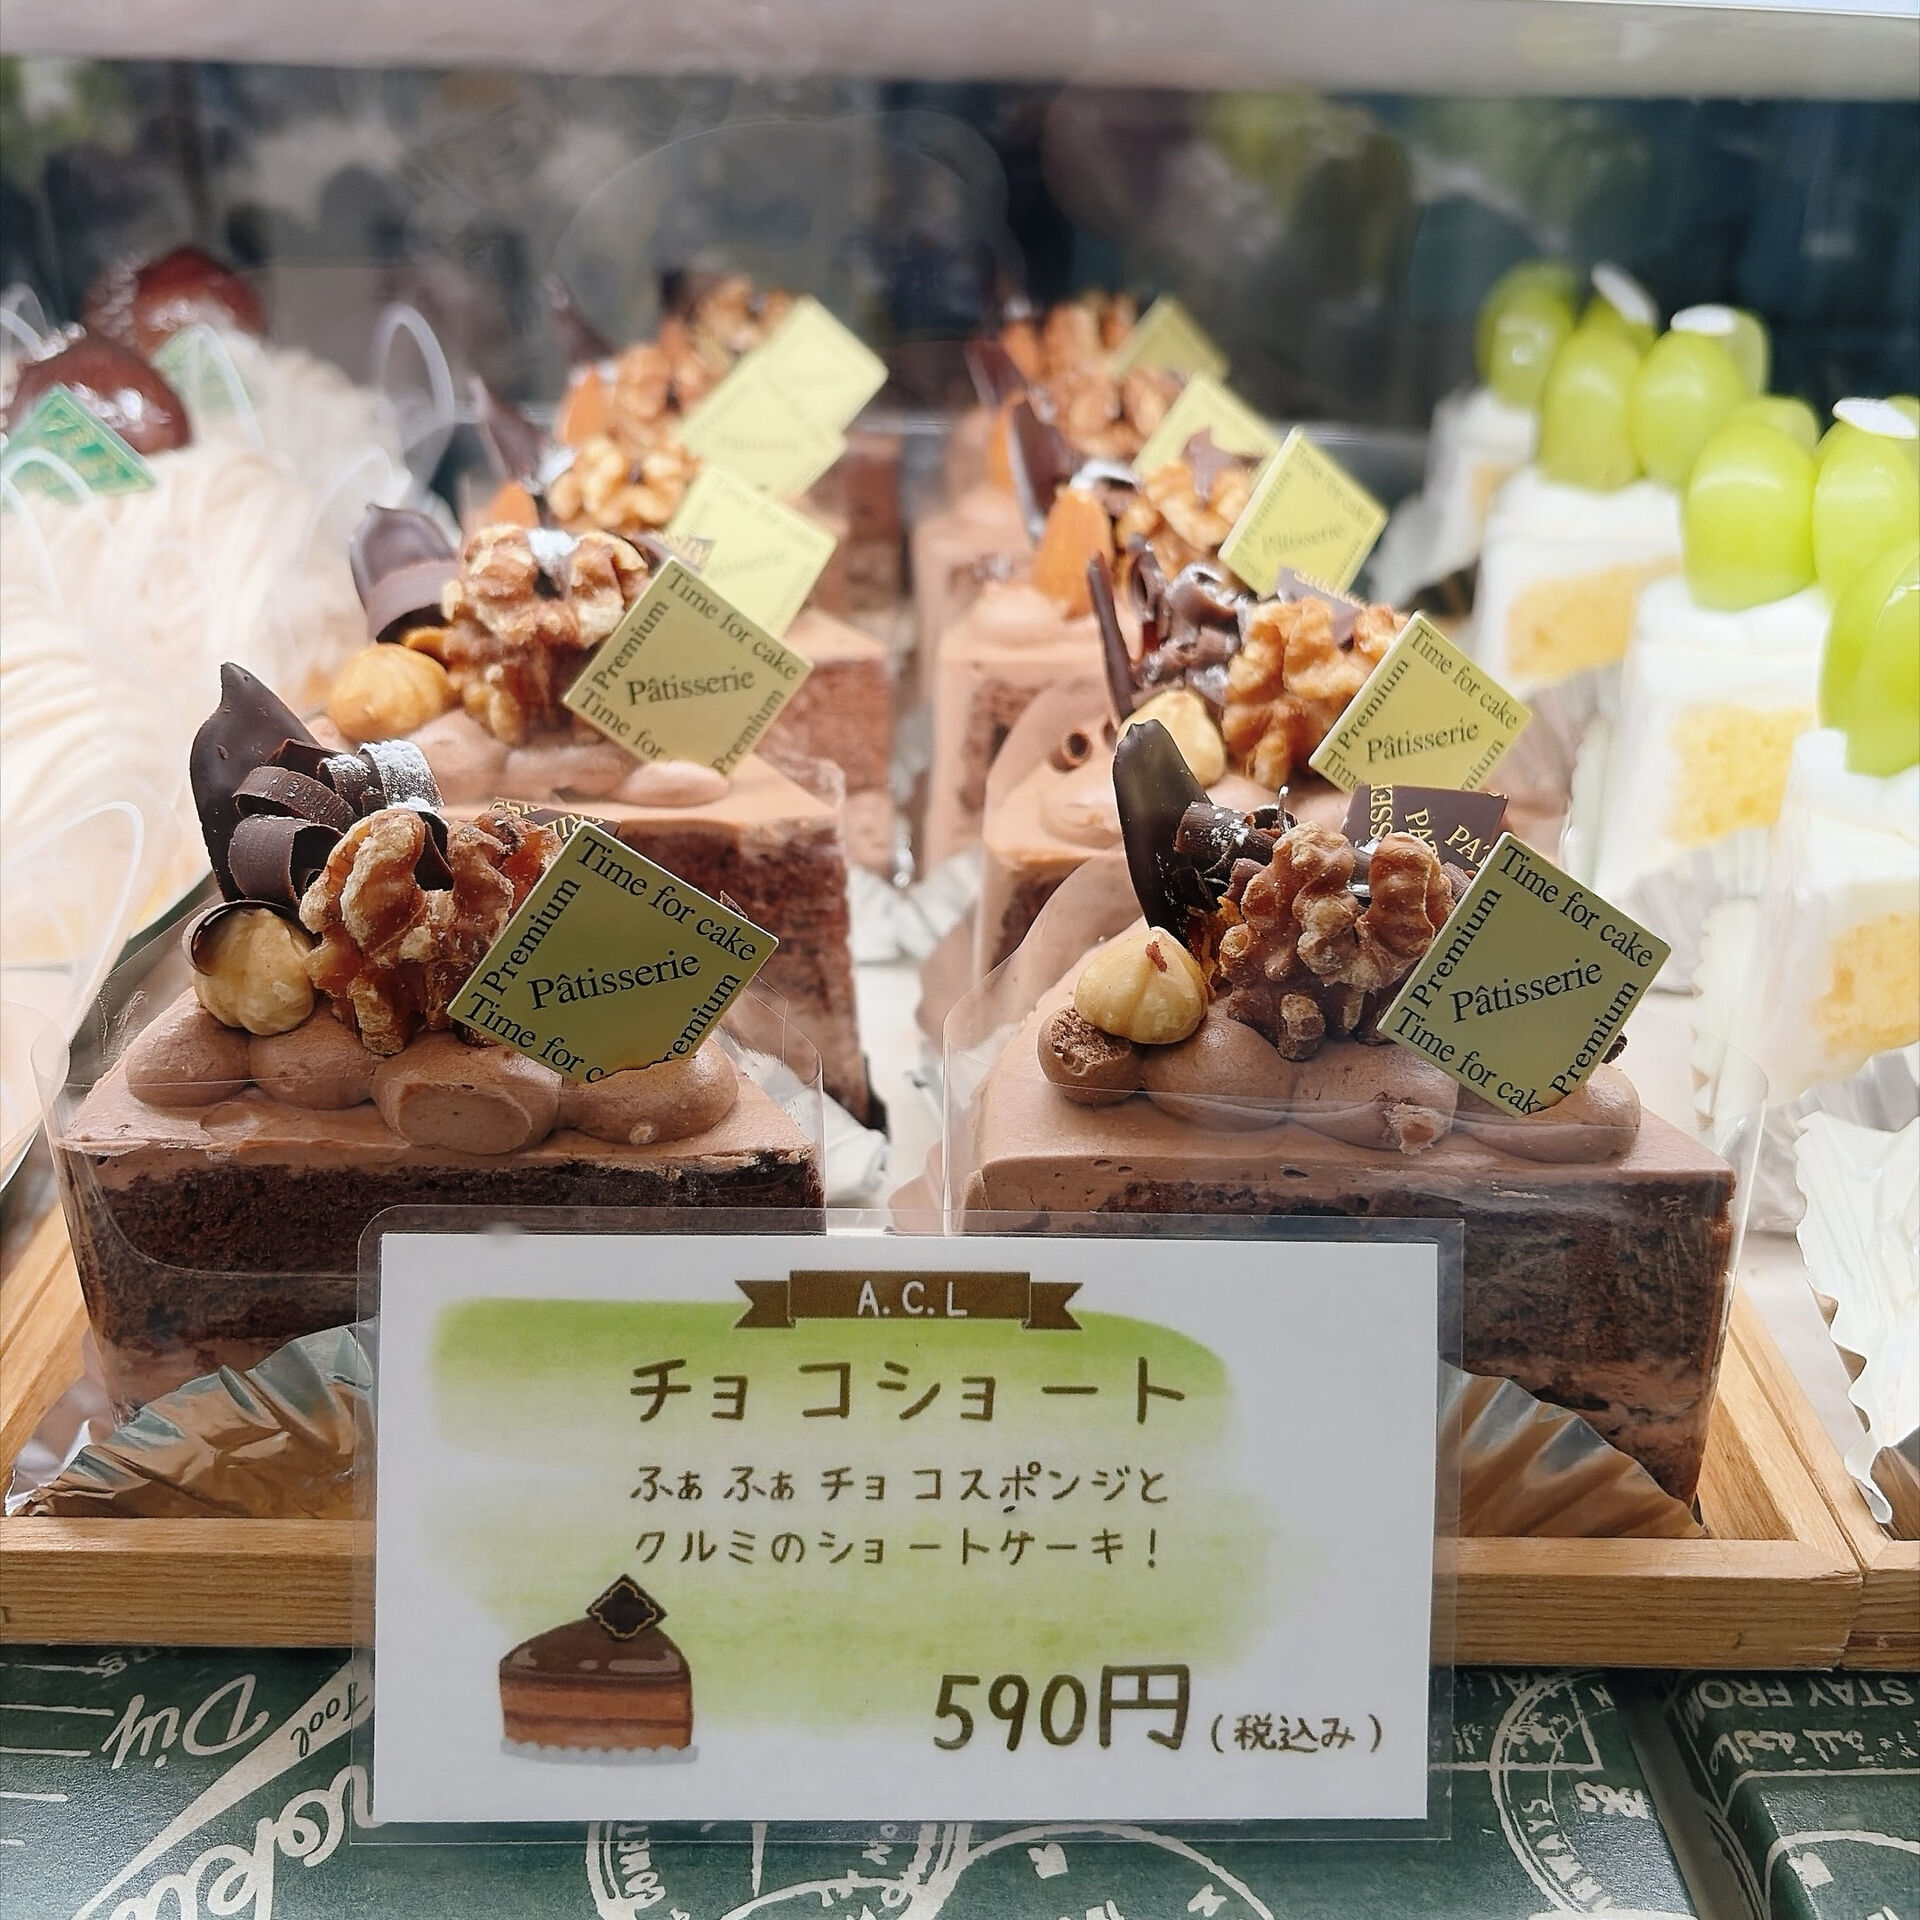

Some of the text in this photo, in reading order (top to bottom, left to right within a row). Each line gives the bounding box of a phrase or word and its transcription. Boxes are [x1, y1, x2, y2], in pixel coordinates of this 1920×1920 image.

[592, 599, 670, 690] Premium
[665, 566, 798, 681] Time for cake
[626, 665, 754, 706] Pâtisserie
[1337, 659, 1409, 750] Premium
[1409, 626, 1517, 731] Time for cake
[579, 687, 665, 758] Time for
[710, 688, 785, 777] Premium
[1366, 717, 1480, 764] Pâtisserie
[481, 878, 582, 996] Premium
[576, 836, 757, 961] Time for cake
[1499, 845, 1653, 968] Time for cake
[527, 950, 701, 1010] Pâtisserie
[1410, 888, 1502, 1008] Premium
[1450, 958, 1603, 1022] Pâtisserie
[465, 992, 536, 1049] Time
[538, 1036, 585, 1075] for
[651, 973, 742, 1064] remium
[1394, 1006, 1453, 1063] Time
[1456, 1051, 1498, 1088] for
[1549, 980, 1639, 1096] Premium
[858, 1280, 968, 1316] A.C.L
[630, 1357, 1186, 1425] チョコショート
[290, 1682, 369, 1757] Tool
[933, 1664, 1190, 1751] 590円
[1808, 1678, 1914, 1707] STAY
